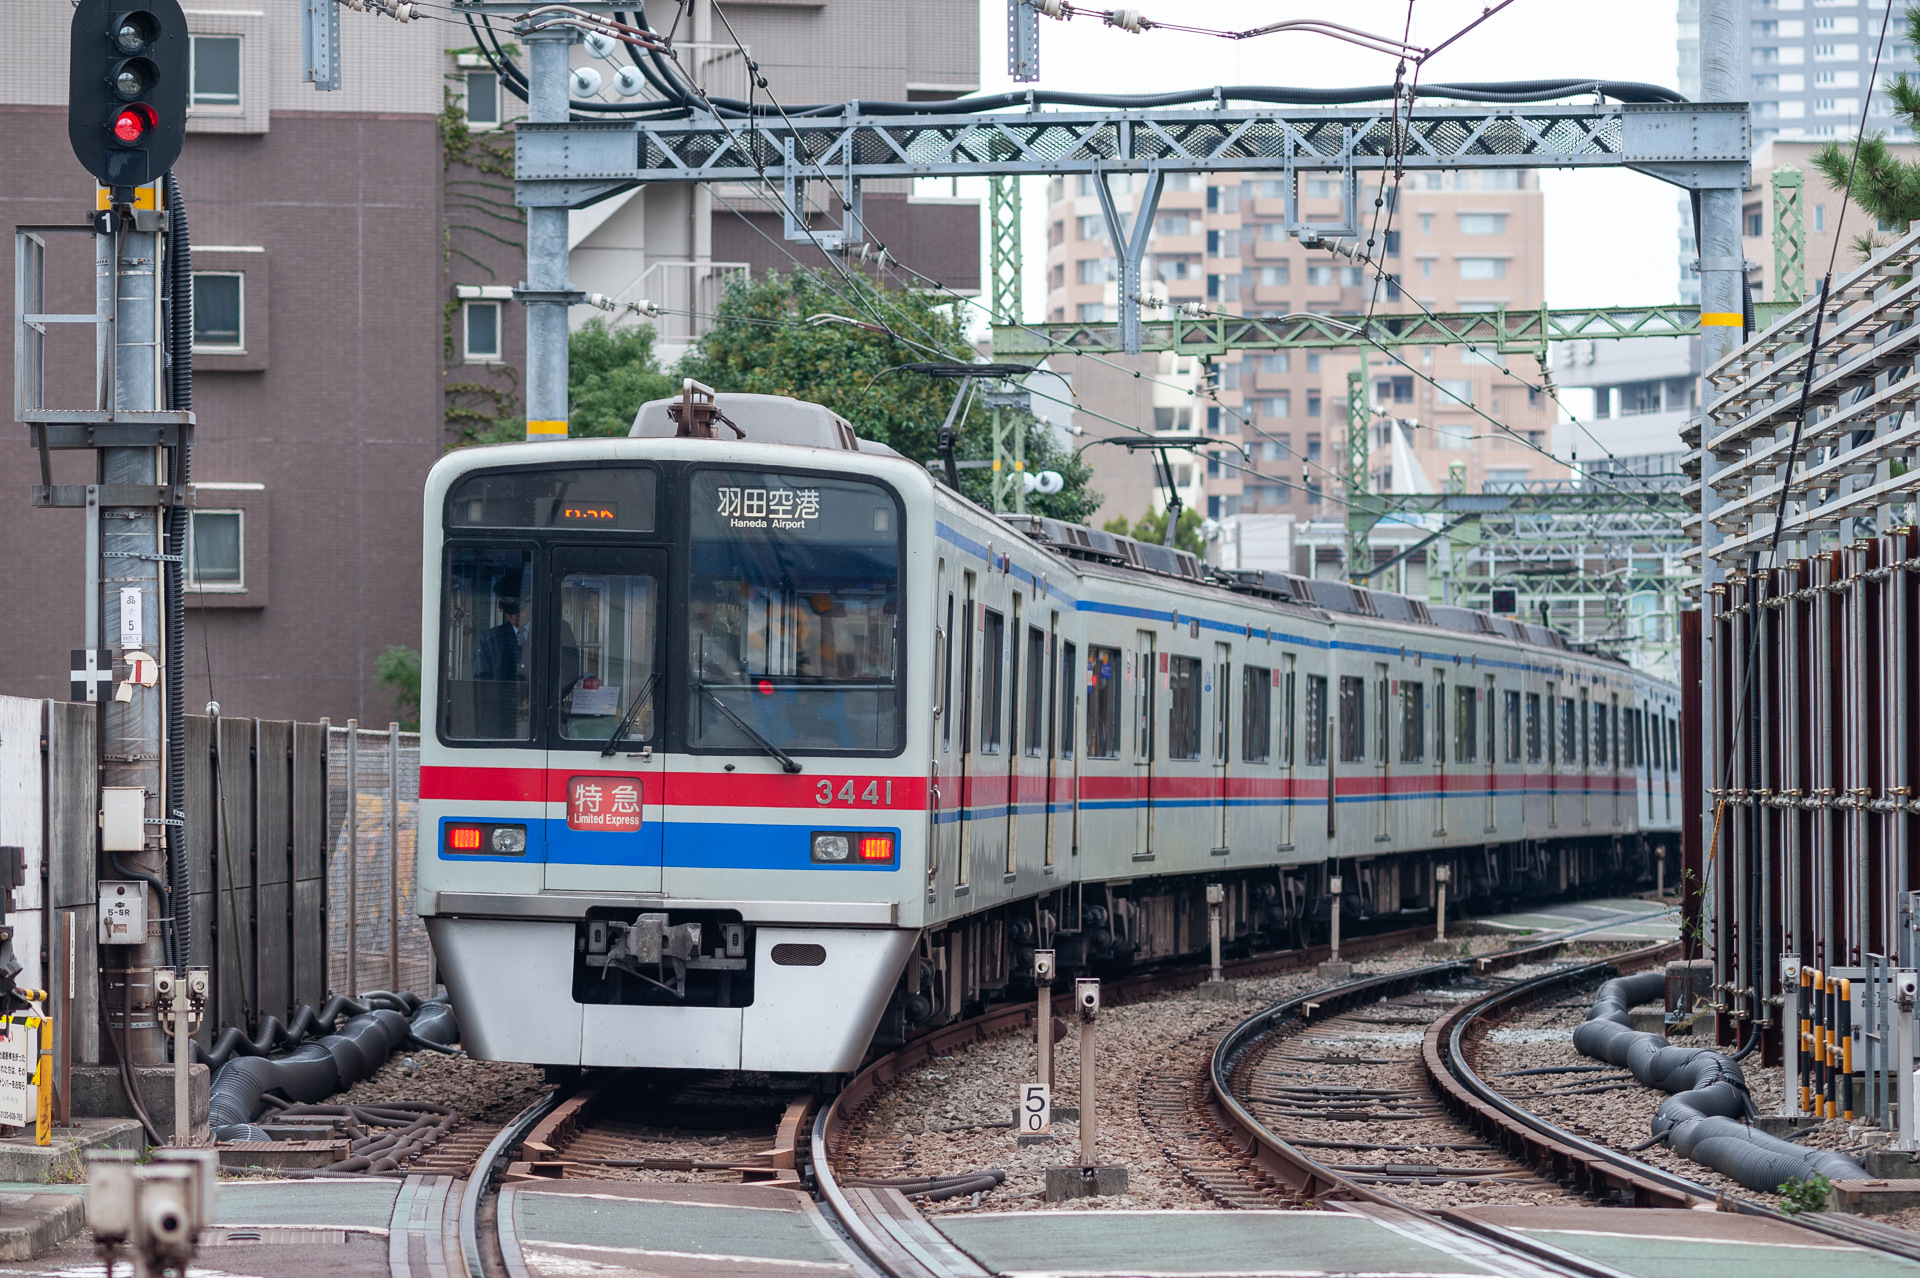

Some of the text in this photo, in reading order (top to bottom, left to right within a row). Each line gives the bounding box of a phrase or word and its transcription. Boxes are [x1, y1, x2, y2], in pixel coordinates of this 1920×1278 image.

[101, 212, 111, 233] 1
[717, 487, 820, 519] 羽田空港
[730, 518, 805, 530] Haneda Airport
[128, 620, 134, 631] 5
[574, 784, 640, 813] 特急
[815, 779, 892, 805] 3441
[574, 813, 640, 827] Limited Express
[1025, 1087, 1046, 1113] 5
[1028, 1113, 1042, 1131] 0
